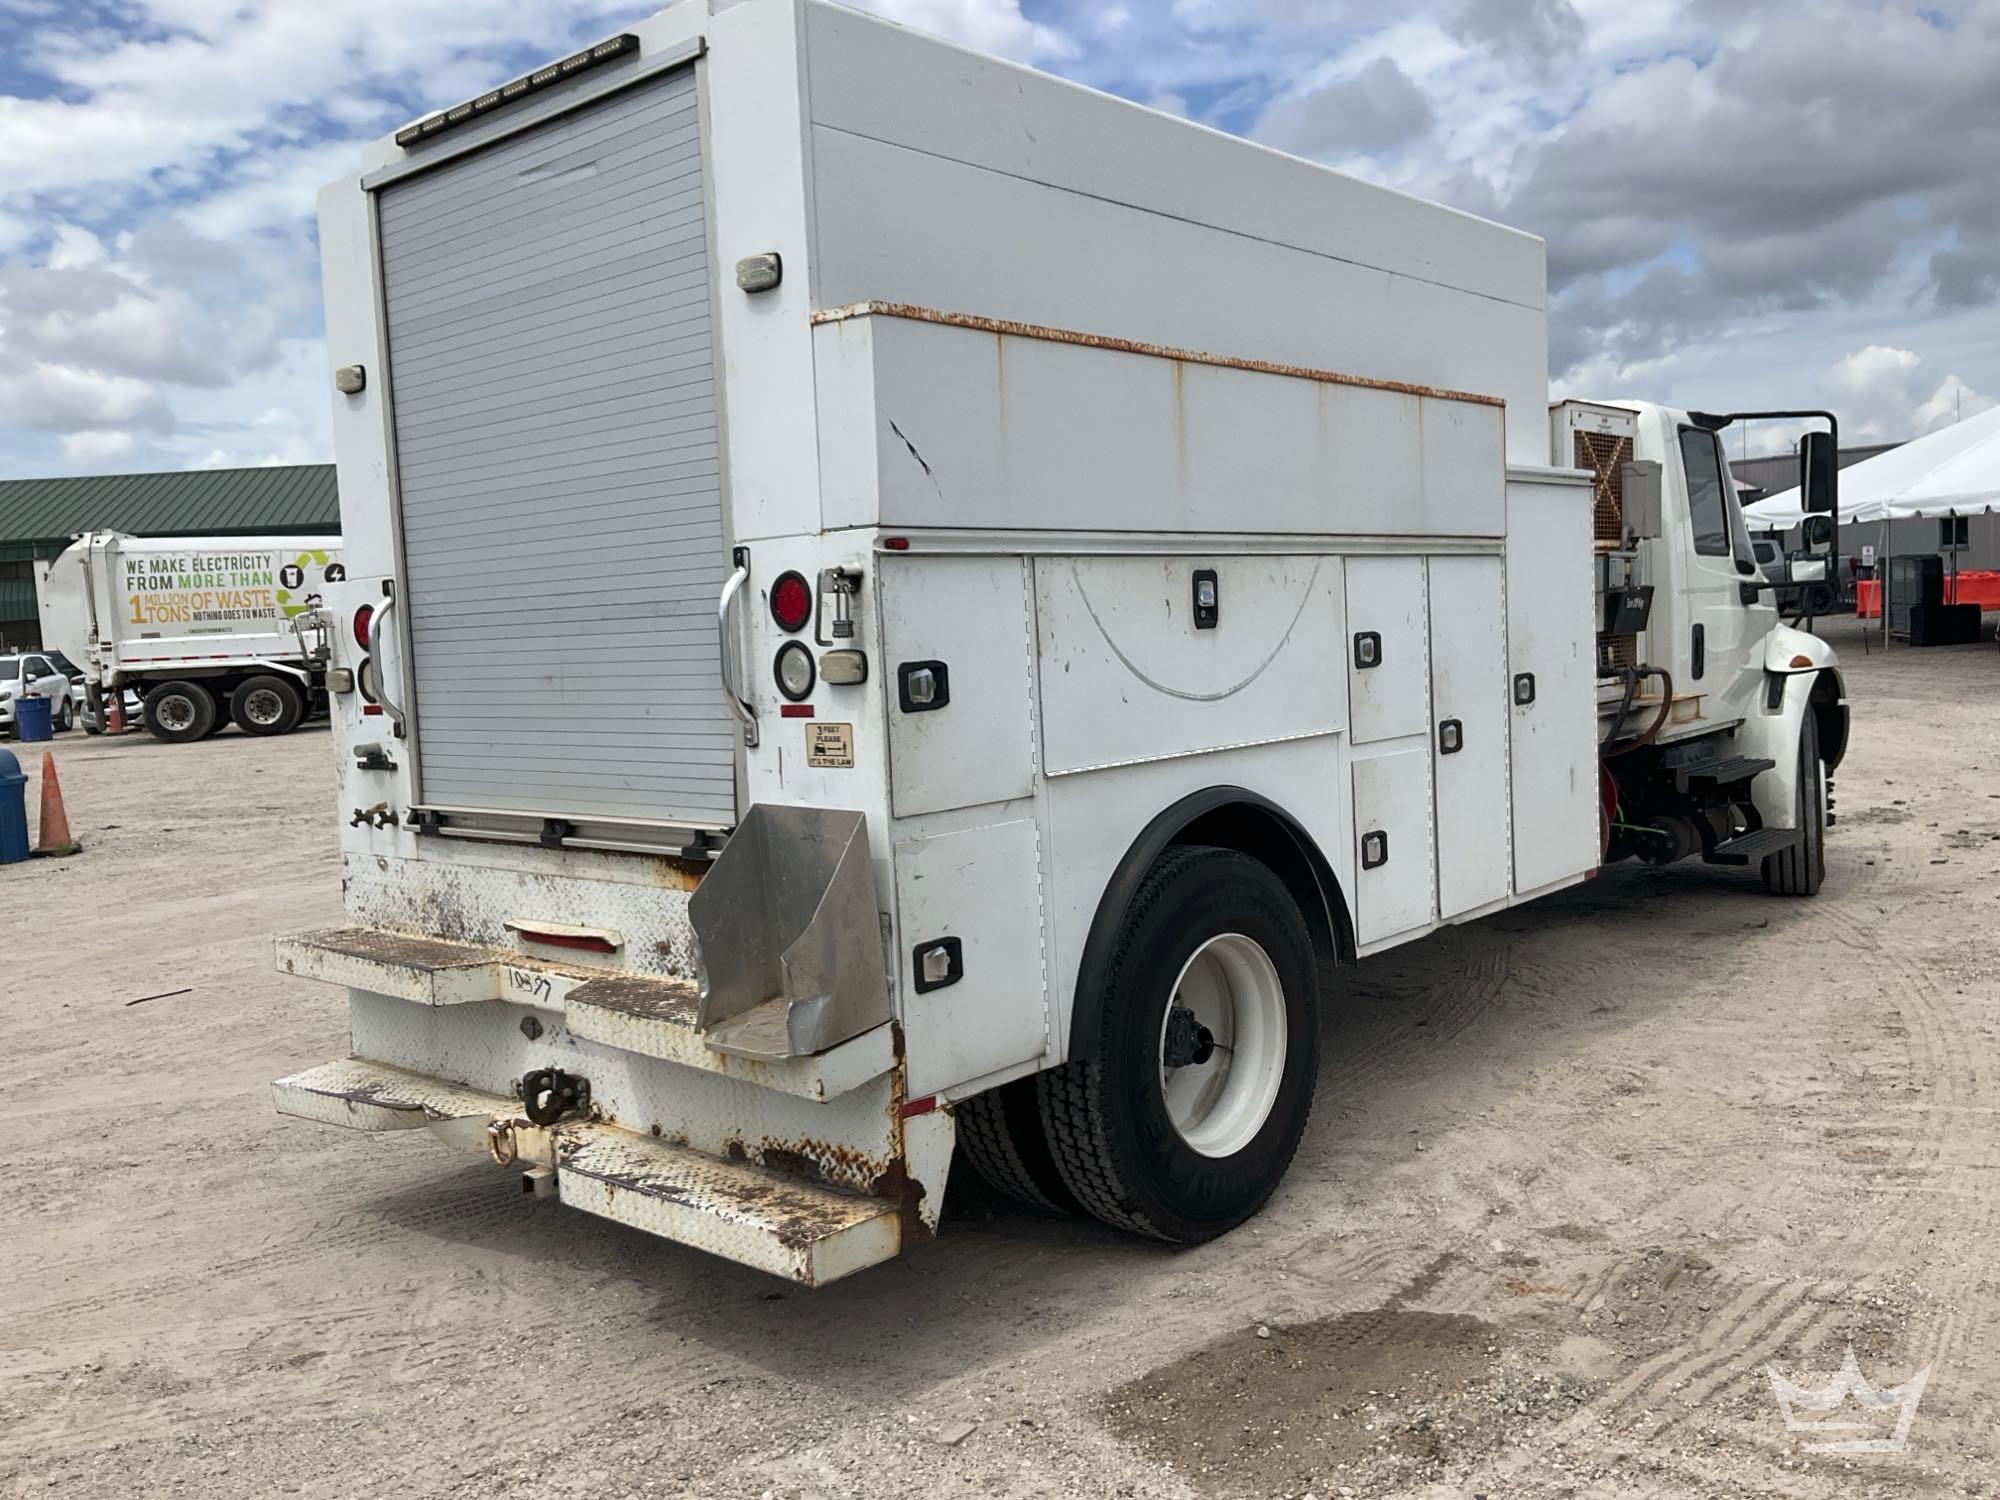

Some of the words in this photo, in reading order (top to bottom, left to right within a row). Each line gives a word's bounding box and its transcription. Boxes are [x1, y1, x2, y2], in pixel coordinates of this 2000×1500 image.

[126, 560, 145, 574] WE
[150, 558, 185, 573] MAKE
[192, 555, 271, 572] ELECTRICITY
[127, 575, 173, 591] FROM
[178, 572, 225, 589] MORE
[230, 571, 273, 587] THAN
[129, 594, 148, 624] 1
[144, 593, 189, 606] MILLION
[191, 591, 212, 611] OF
[215, 589, 275, 609] WASTE.
[144, 605, 191, 624] TONS
[193, 610, 223, 621] NOTHING
[223, 609, 241, 620] GOES
[242, 609, 251, 620] TO
[251, 608, 276, 619] WASTE
[816, 726, 822, 735] 3
